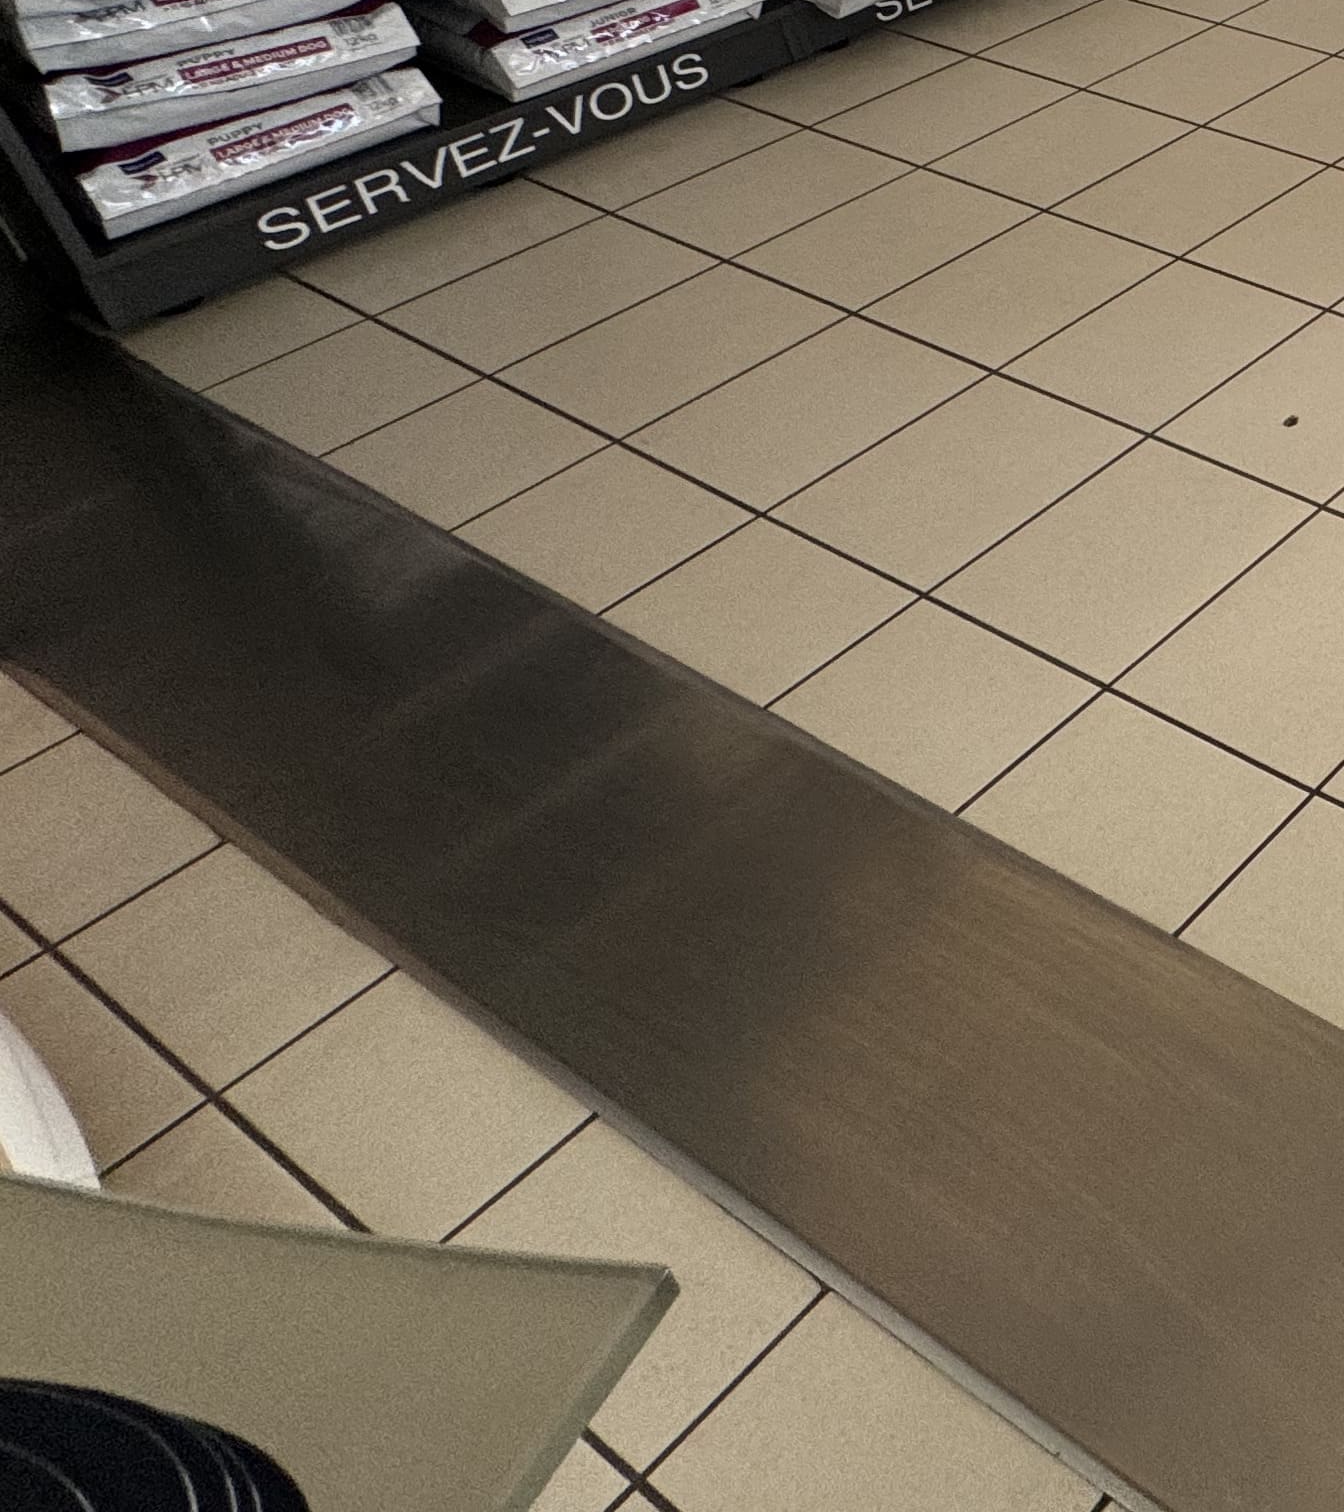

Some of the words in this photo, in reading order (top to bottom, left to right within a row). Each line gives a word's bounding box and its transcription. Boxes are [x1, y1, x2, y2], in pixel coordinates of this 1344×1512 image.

[589, 6, 638, 29] JUNIOR
[177, 47, 237, 68] PUPPY
[242, 45, 299, 69] MEDIUM
[299, 38, 329, 54] DOG
[206, 121, 265, 147] PUPPY
[255, 51, 711, 252] SERVEZ-VOUS
